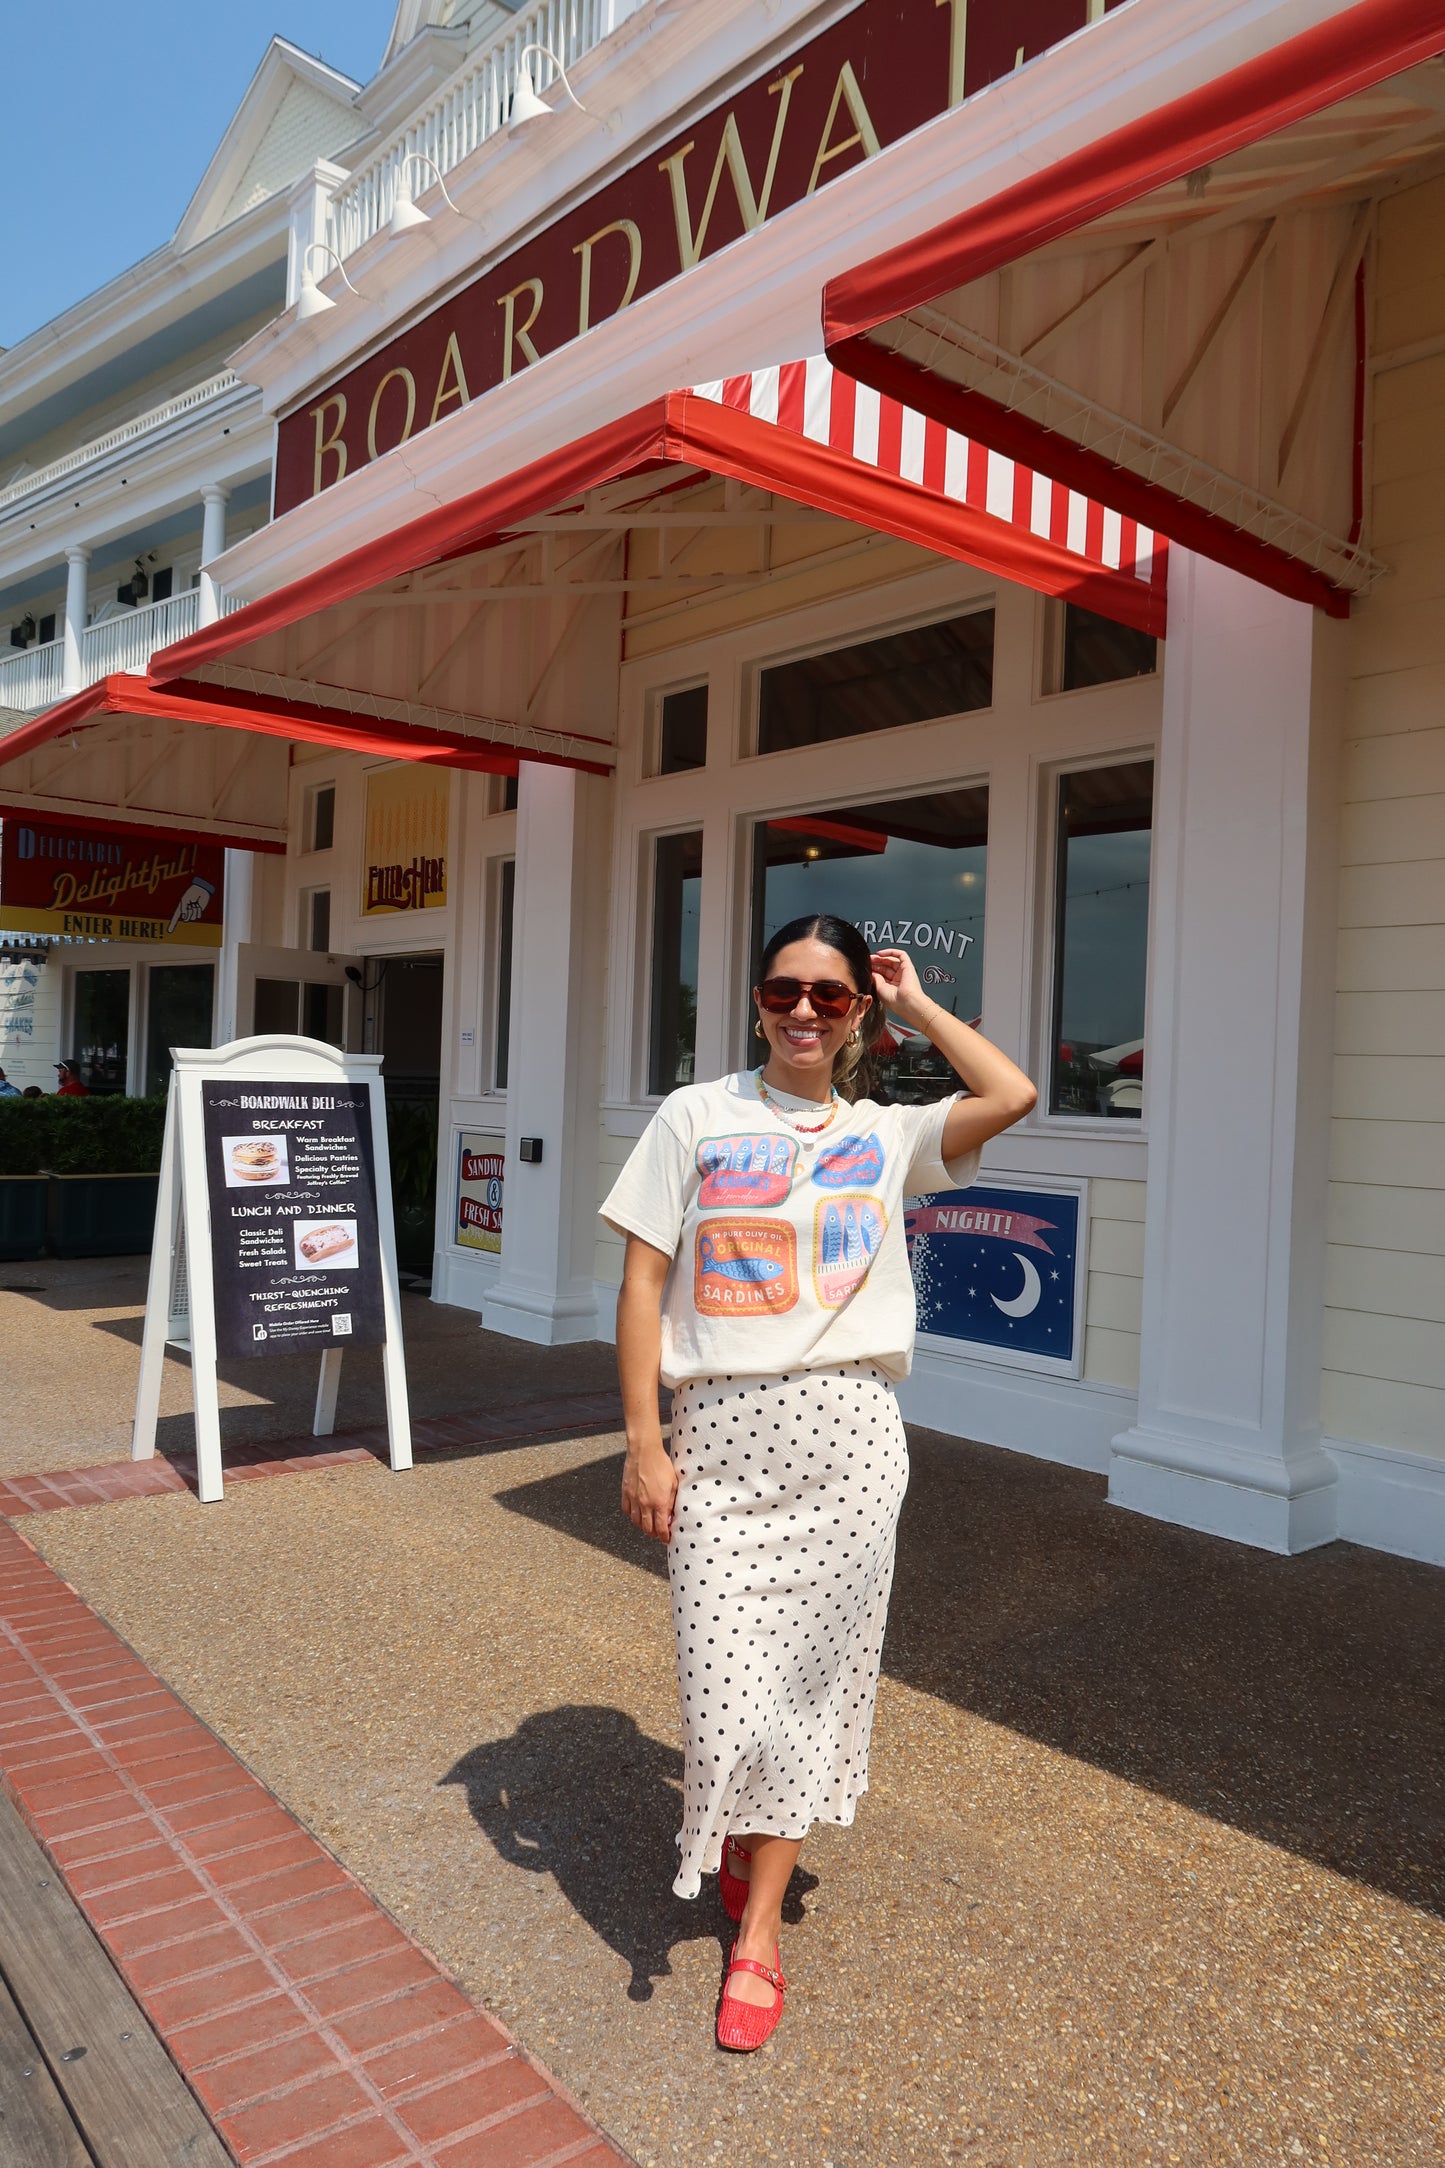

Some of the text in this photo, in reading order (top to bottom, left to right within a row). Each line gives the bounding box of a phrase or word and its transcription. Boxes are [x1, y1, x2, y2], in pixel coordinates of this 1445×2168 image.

[309, 0, 1106, 496] BOARDWAL
[45, 843, 198, 911] Delightful!
[63, 914, 164, 939] ENTER HERE!
[240, 1095, 335, 1110] BOARDWALK DELI
[252, 1120, 325, 1130] BREAKFAST
[305, 1143, 347, 1151] Sandwiches
[295, 1164, 360, 1174] Specialty Coffees
[467, 1158, 504, 1177] SANDWI
[491, 1183, 498, 1202] &
[231, 1203, 357, 1217] LUNCH AND DINNER
[464, 1201, 489, 1227] FRESH
[935, 1210, 1013, 1234] NIGHT!
[240, 1228, 283, 1237] Classic Deli
[723, 1230, 743, 1239] PURE
[746, 1231, 768, 1240] OLIVE
[770, 1233, 783, 1242] OIL
[240, 1237, 284, 1245] Sandwiches
[717, 1240, 781, 1257] ORIGINAL
[239, 1259, 288, 1268] Sweet Treats
[249, 1286, 350, 1301] THIRST-QUENCHING
[702, 1282, 785, 1304] SARDINES
[264, 1299, 339, 1312] REFRESHMENTS
